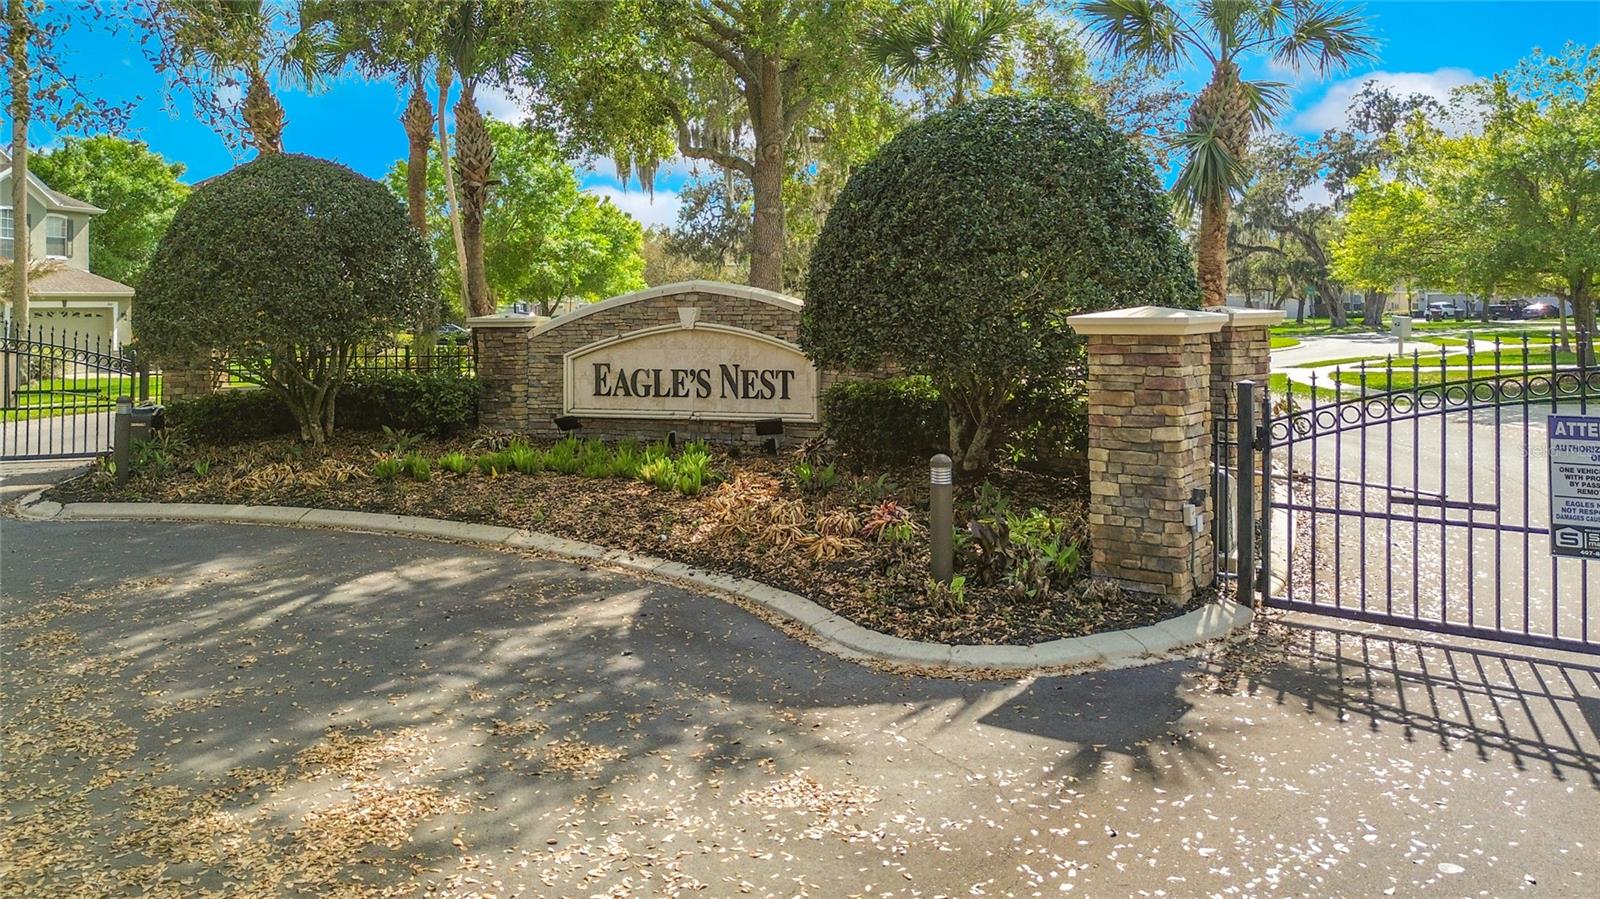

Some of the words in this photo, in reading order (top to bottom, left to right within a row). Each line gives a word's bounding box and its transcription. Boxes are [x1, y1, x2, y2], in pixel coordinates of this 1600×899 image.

[592, 362, 712, 398] EAGLE'S
[719, 364, 795, 400] NEST
[1555, 421, 1600, 437] ATTE
[1559, 466, 1574, 474] ONE
[1576, 467, 1600, 475] VEHIC
[1564, 473, 1583, 481] WITH
[1565, 500, 1595, 508] EAGLES
[1561, 506, 1576, 514] NOT
